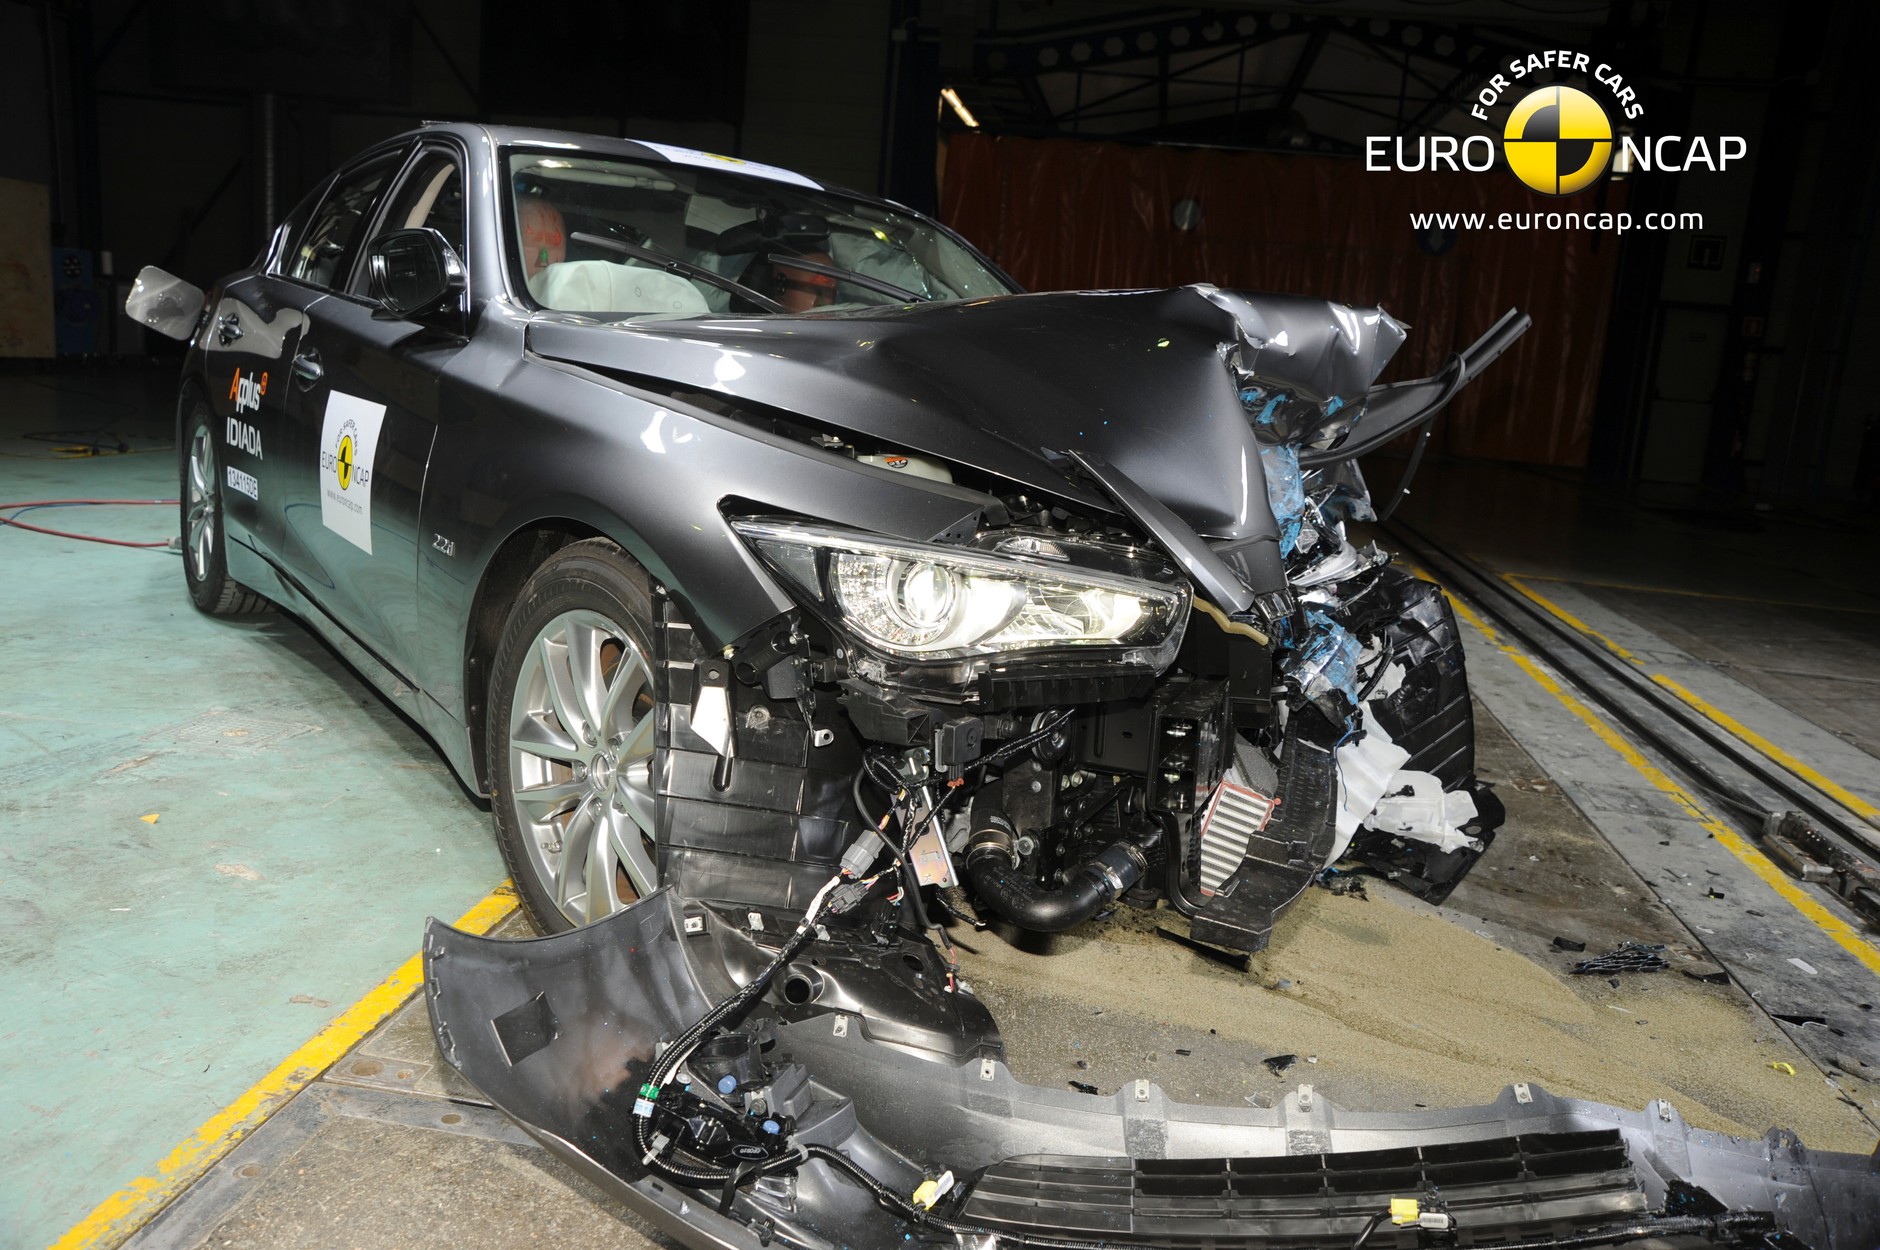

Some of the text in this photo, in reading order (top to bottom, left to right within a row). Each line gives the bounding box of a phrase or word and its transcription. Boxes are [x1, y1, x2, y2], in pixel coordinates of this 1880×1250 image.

[229, 367, 262, 414] Applus
[226, 416, 263, 460] IDIADA
[343, 418, 356, 431] SAFER
[321, 451, 370, 488] EURO NCAP
